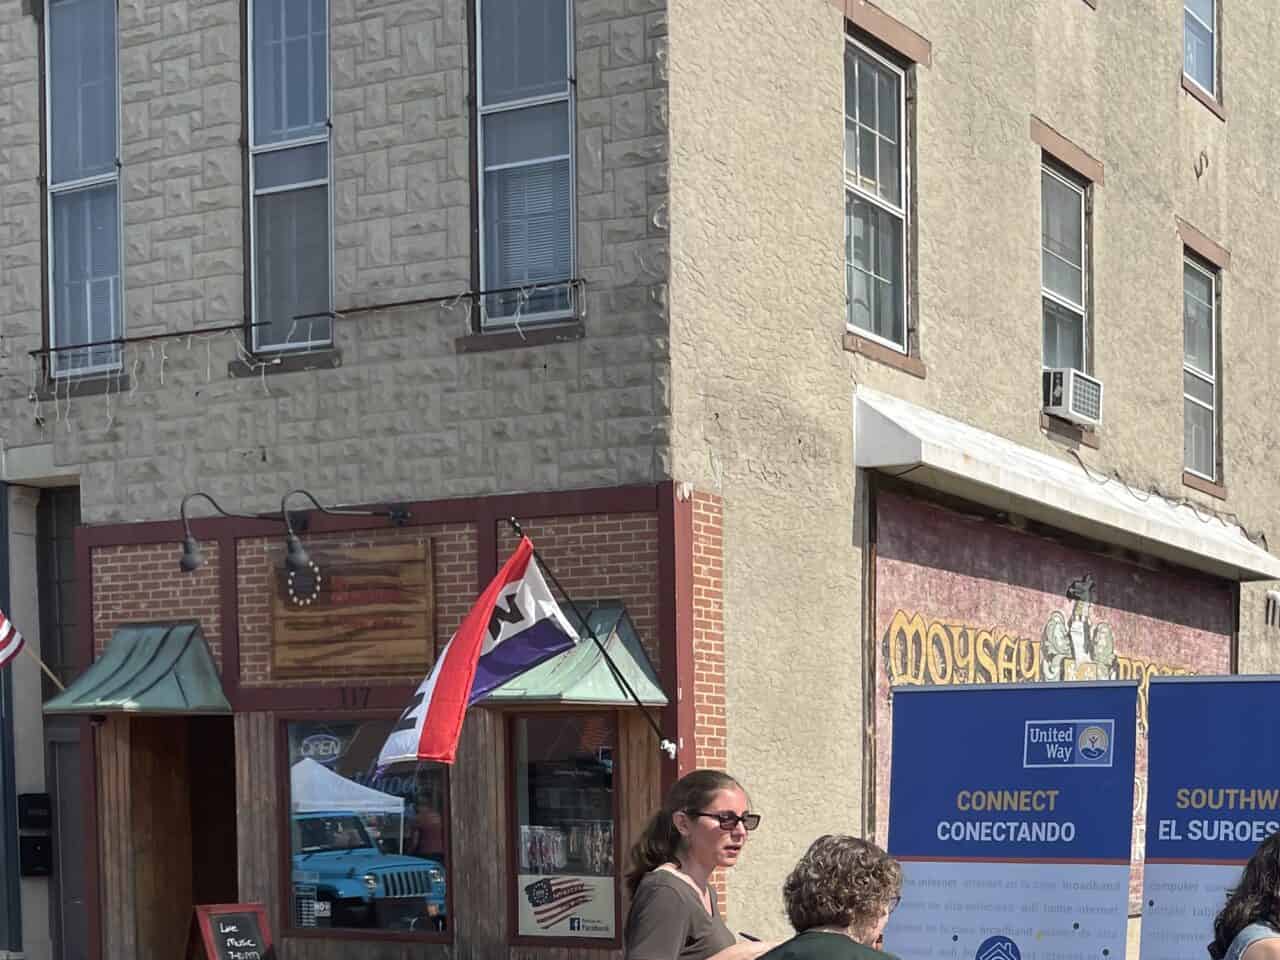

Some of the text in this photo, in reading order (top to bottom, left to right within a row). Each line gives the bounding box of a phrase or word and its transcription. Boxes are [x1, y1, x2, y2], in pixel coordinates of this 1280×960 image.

[1029, 727, 1073, 744] United
[1046, 743, 1073, 763] Way
[956, 789, 1059, 812] CONNECT
[936, 820, 1076, 843] CONECTANDO
[1158, 819, 1183, 842] EL
